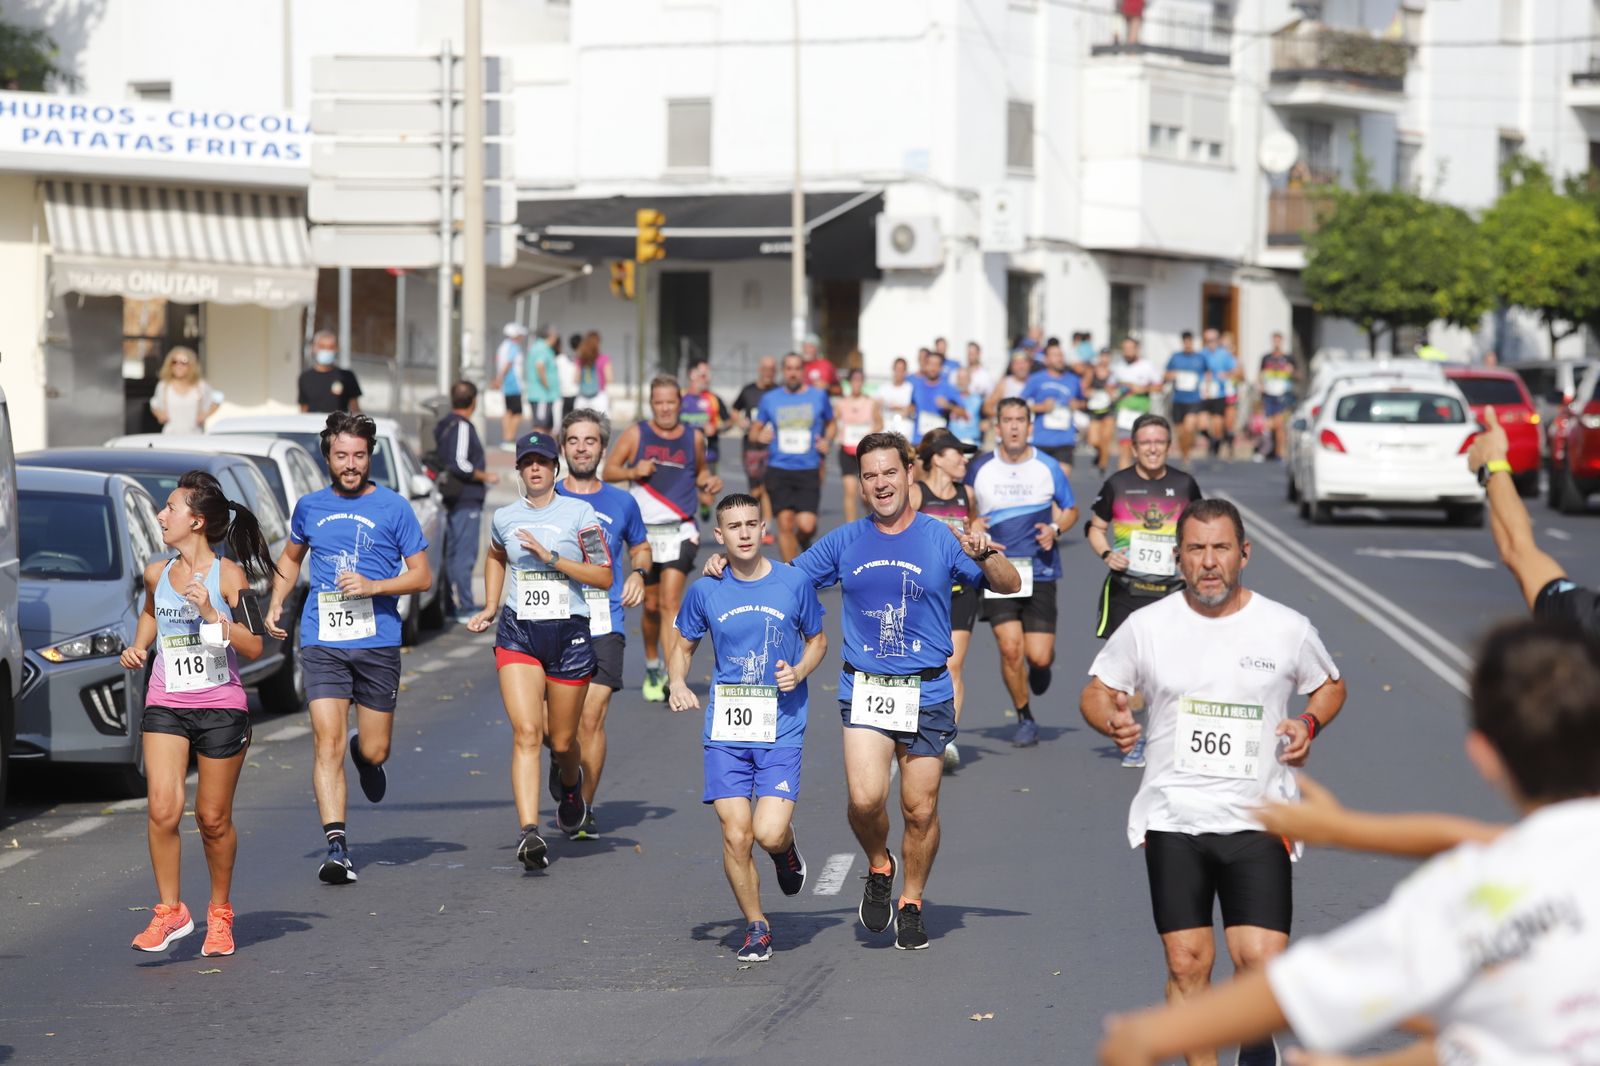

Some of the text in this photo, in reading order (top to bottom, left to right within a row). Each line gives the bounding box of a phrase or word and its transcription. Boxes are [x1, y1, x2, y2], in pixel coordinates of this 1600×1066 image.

[22, 127, 302, 161] PATATAS FRITAS
[127, 269, 219, 297] ONUTAPI
[1138, 548, 1162, 563] 579
[863, 559, 889, 569] VUELTA
[896, 560, 923, 575] HUELVA
[525, 590, 550, 606] 299
[328, 610, 354, 628] 375
[728, 604, 754, 616] VUELTA
[760, 605, 785, 621] HUELVA
[173, 635, 191, 647] VUELTA
[191, 636, 197, 645] A
[571, 637, 586, 646] FILA
[174, 655, 205, 677] 118
[1254, 660, 1275, 671] CNN
[888, 678, 894, 687] A
[725, 687, 745, 696] VUELTA
[745, 687, 750, 697] A
[750, 688, 773, 697] HUELVA
[865, 695, 896, 715] 129
[1194, 702, 1222, 717] VUELTA
[1222, 704, 1230, 717] A
[1230, 705, 1258, 719] HUELVA
[725, 707, 753, 726] 130
[1190, 730, 1232, 756] 566
